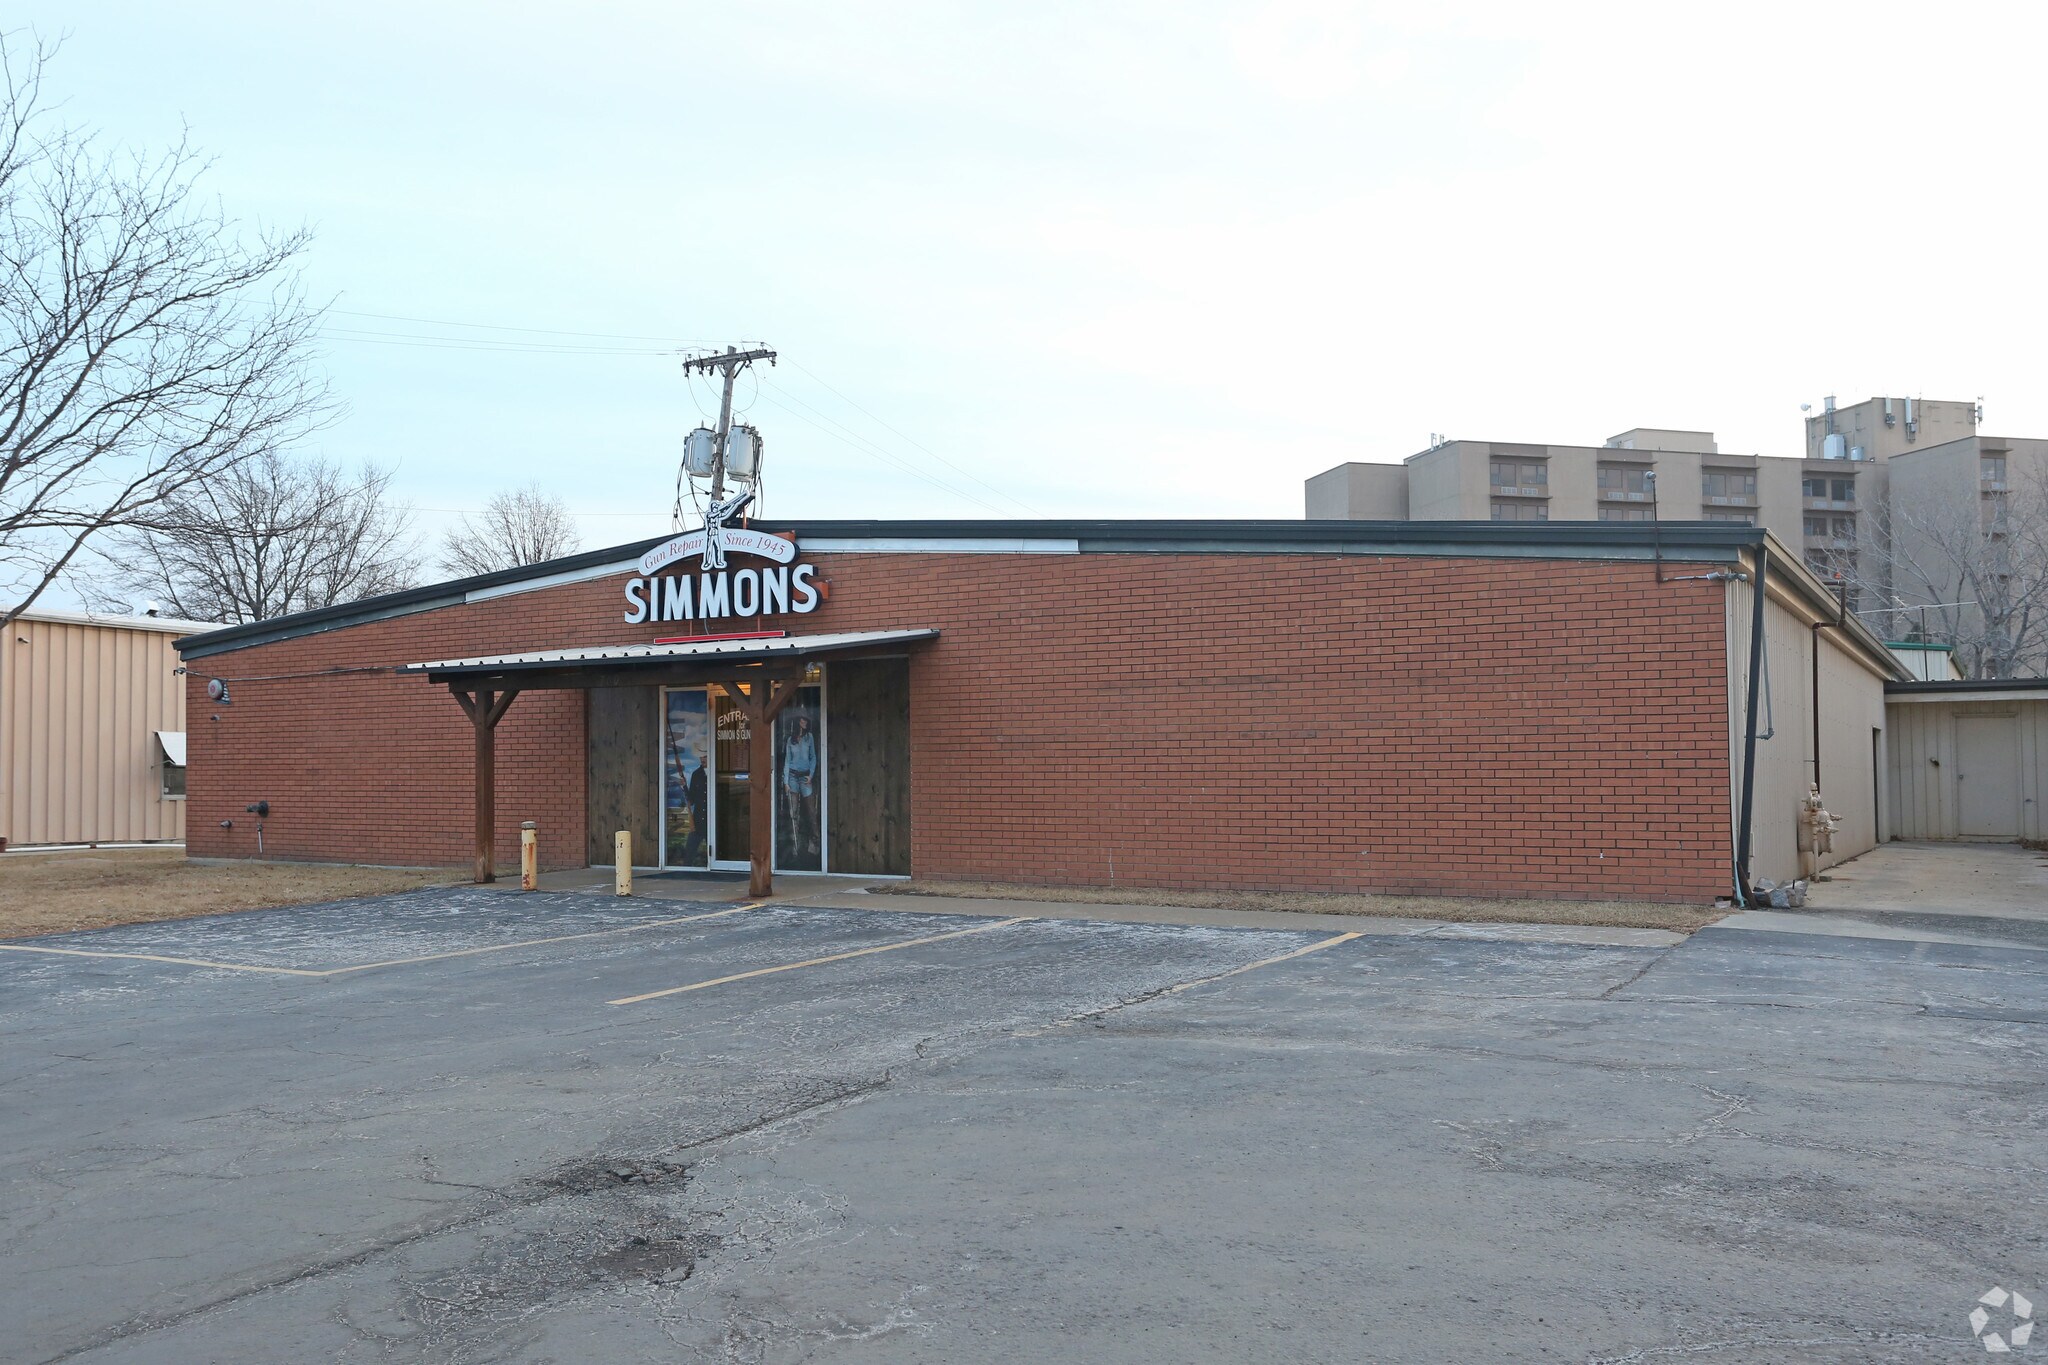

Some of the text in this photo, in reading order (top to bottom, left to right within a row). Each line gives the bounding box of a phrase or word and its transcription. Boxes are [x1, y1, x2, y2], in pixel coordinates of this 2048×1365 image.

[644, 532, 786, 570] Gun Repair Since 1945
[624, 563, 818, 624] SIMMONS
[717, 710, 750, 728] ENTRA
